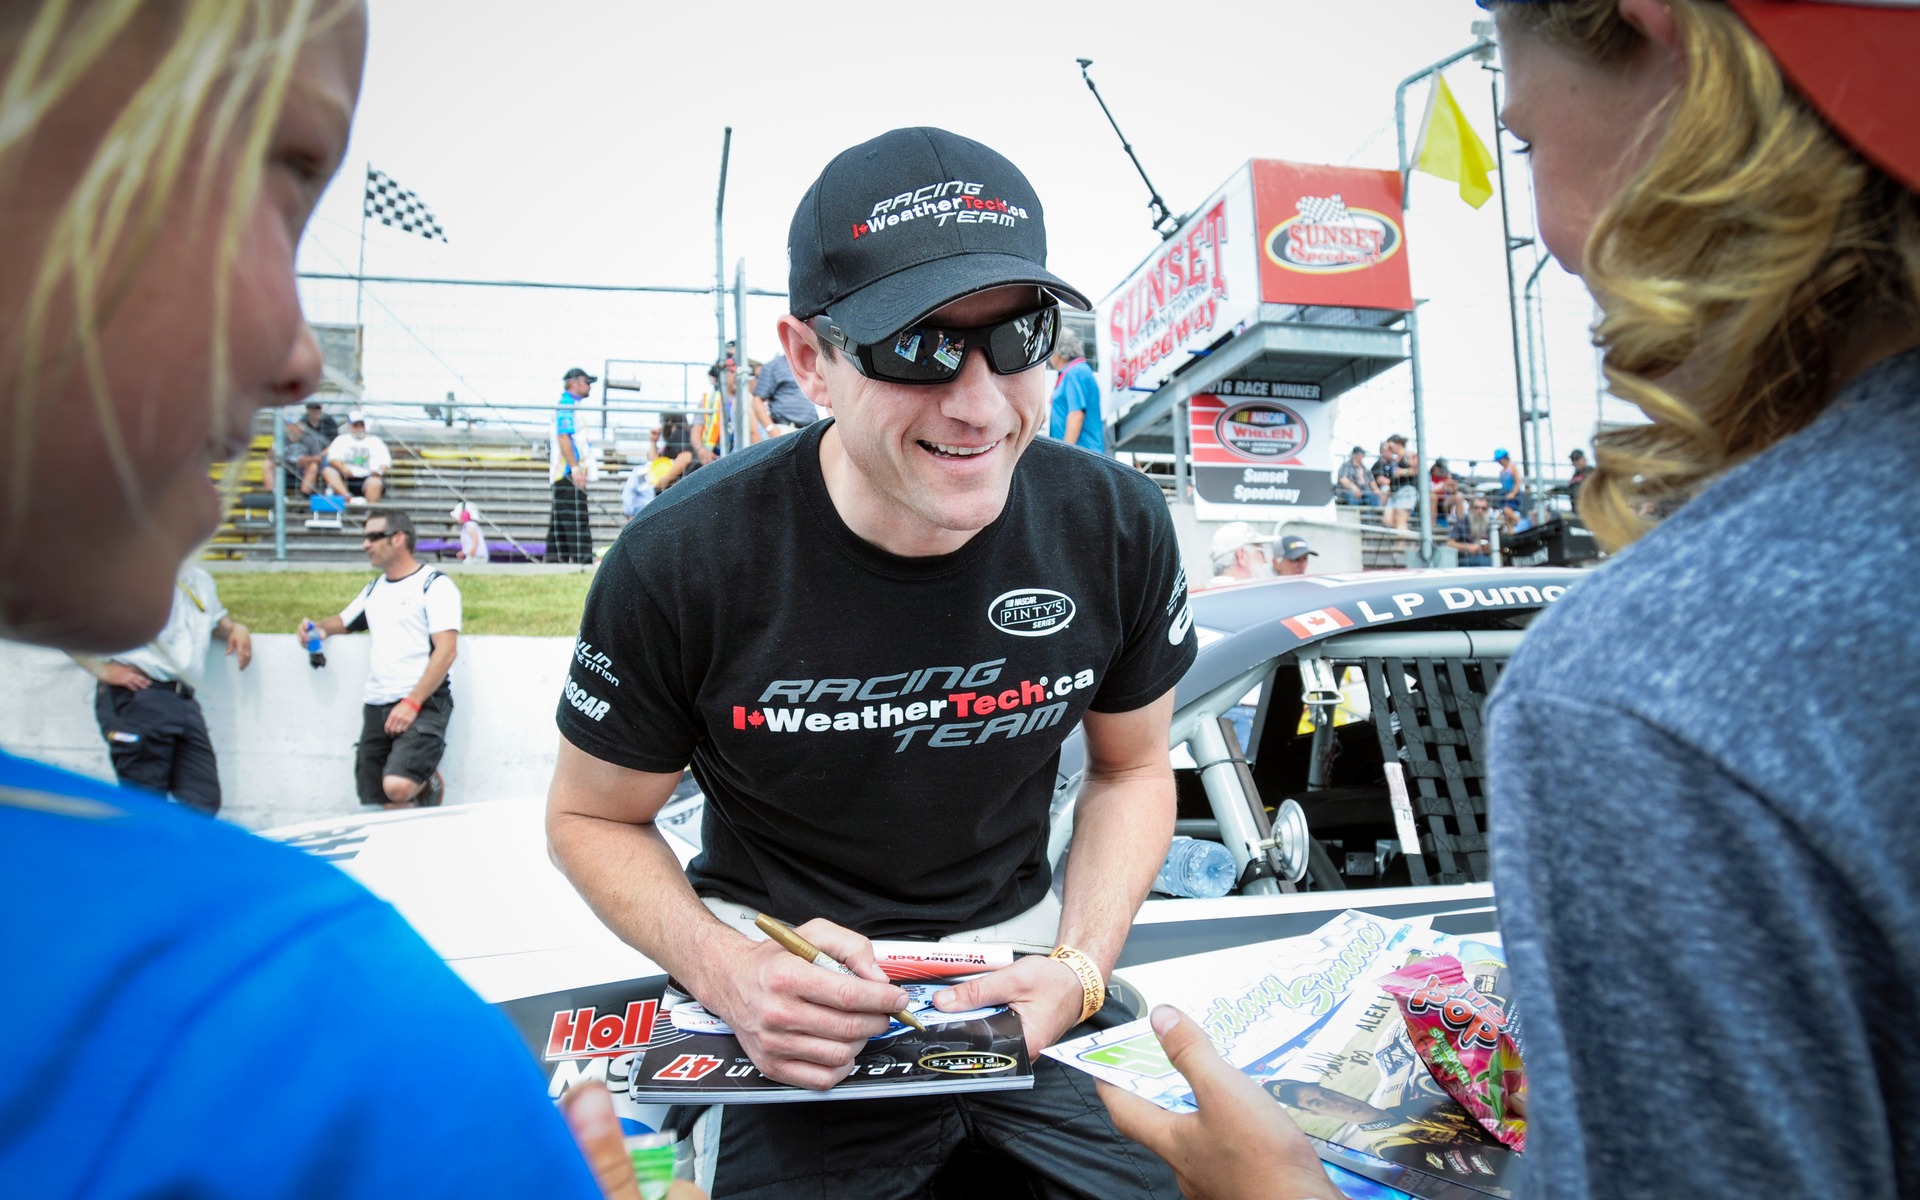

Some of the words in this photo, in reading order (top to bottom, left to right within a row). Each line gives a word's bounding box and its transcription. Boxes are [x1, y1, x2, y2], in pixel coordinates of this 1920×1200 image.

[870, 180, 984, 217] RACING
[934, 210, 1015, 227] TEAM
[1289, 224, 1384, 257] SUNSET
[1291, 246, 1377, 268] Speedway
[1110, 196, 1228, 386] SUNSET
[1116, 296, 1217, 391] Speedway
[1204, 381, 1233, 394] 016
[1235, 381, 1269, 396] RACE
[1271, 382, 1321, 399] WINNER
[1251, 411, 1287, 425] NASCAR
[1233, 425, 1294, 440] WHELEN
[1243, 468, 1289, 484] Sunset
[1233, 485, 1300, 503] Speedway
[1438, 585, 1573, 610] Dumo
[1003, 602, 1064, 623] PINTY'S
[1032, 618, 1056, 629] SERIES
[757, 657, 1007, 704] RACING
[893, 701, 1069, 753] TEAM
[886, 953, 987, 965] WeatherTech
[1288, 922, 1386, 1016] Simone
[545, 998, 659, 1057] Holl
[1356, 1001, 1392, 1033] ALEX
[652, 1054, 724, 1080] 47
[866, 1062, 914, 1076] L.P.
[931, 1056, 997, 1067] PINTY'S
